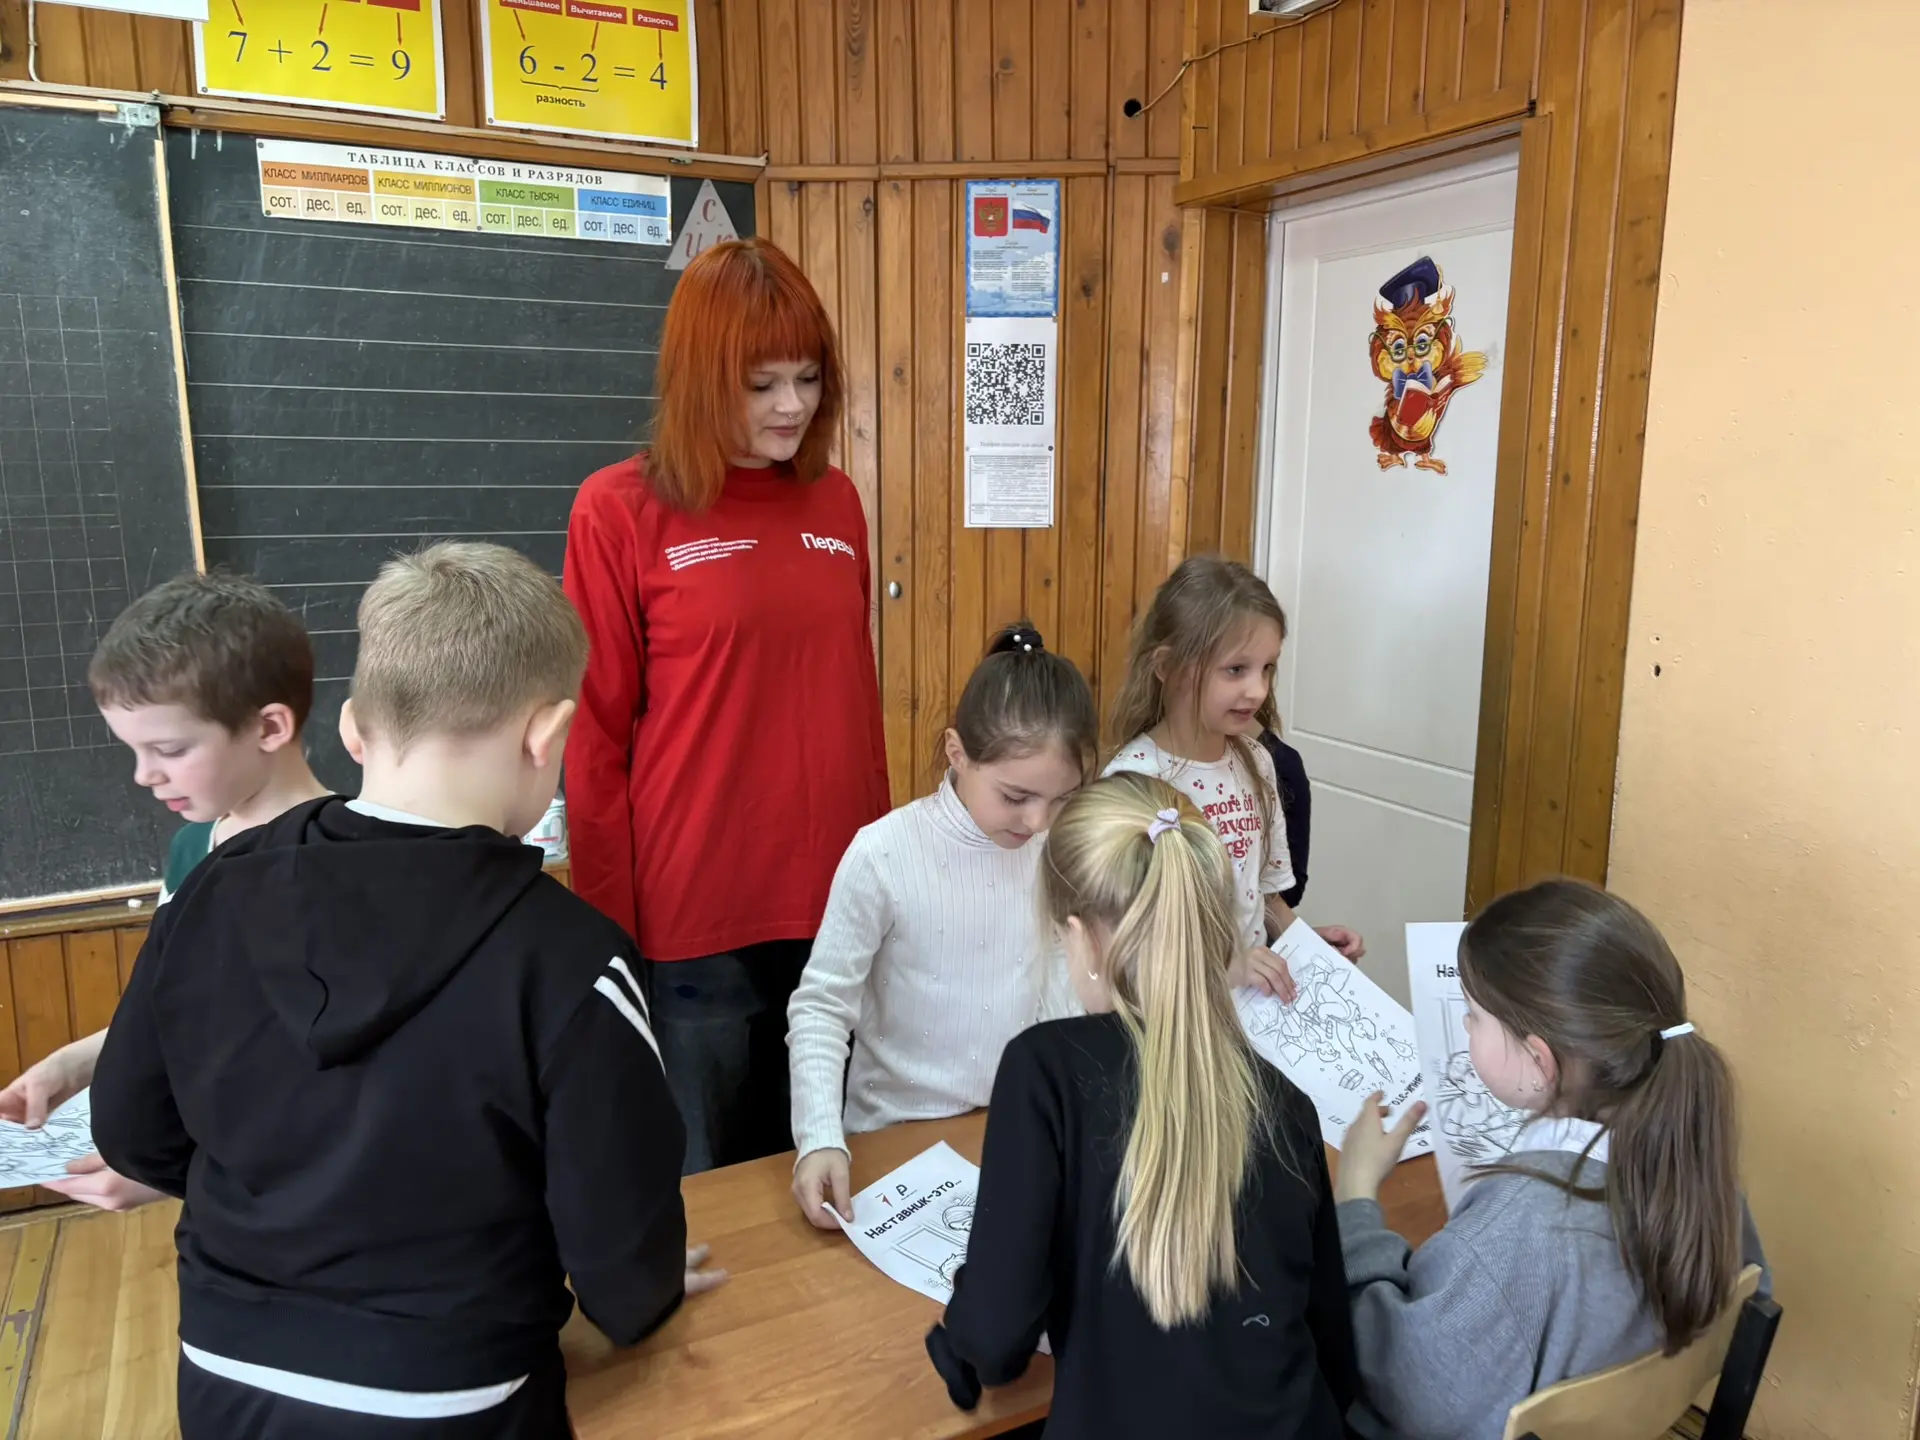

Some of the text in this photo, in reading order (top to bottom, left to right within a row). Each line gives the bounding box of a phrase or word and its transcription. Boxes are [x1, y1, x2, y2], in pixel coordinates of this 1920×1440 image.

[571, 5, 622, 19] Вычитаемое
[637, 14, 674, 27] Разность
[228, 31, 411, 80] 7 + 2 = 9
[519, 45, 537, 75] 6
[581, 53, 598, 83] 2
[613, 66, 635, 78] =
[650, 62, 667, 90] 4
[536, 93, 586, 108] разность
[264, 168, 368, 186] КЛАСС МИЛЛИАРДОВ
[347, 152, 603, 185] ТАБЛИЦА КЛАССОВ И РАЗРЯДОВ
[378, 179, 472, 194] КЛАСС МИЛЛИОНОВ
[496, 188, 559, 202] КЛАСС ТЫСЯЧ
[270, 195, 367, 215] сот. дес. ед.
[591, 195, 656, 210] КЛАСС ЕДИНИЦ
[381, 204, 471, 222] сот. дес. ед.
[486, 212, 570, 230] сот. дес. ед.
[584, 220, 663, 237] сот. дес. ед.
